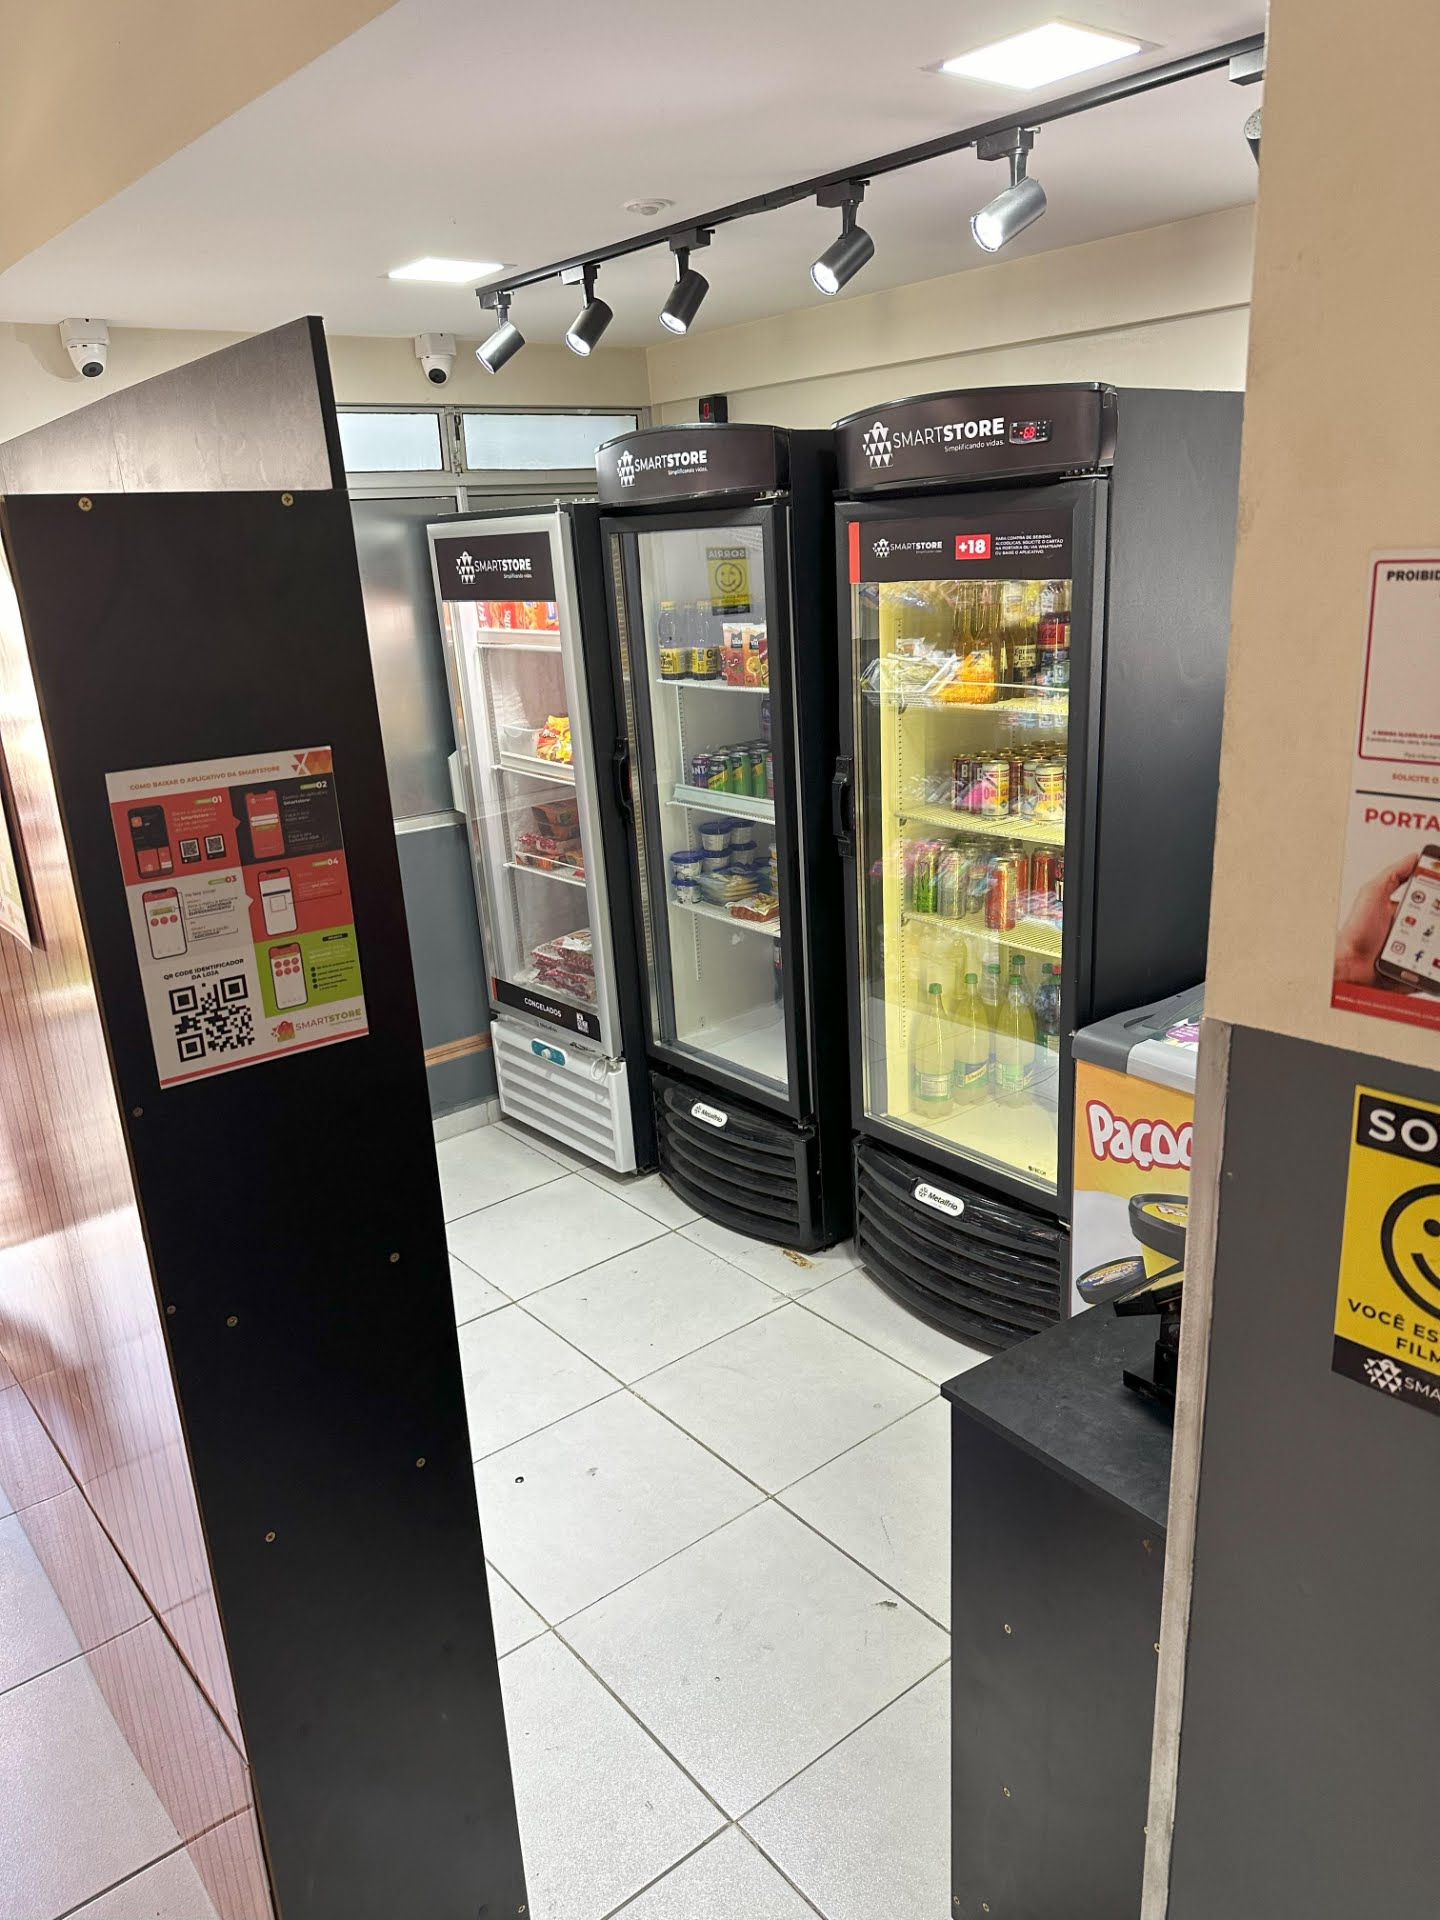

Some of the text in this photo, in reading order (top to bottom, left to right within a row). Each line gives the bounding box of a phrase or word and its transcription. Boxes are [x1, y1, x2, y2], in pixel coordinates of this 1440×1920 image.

[892, 417, 1005, 448] SMARTSTORE
[944, 442, 985, 452] Simplificando
[634, 450, 708, 472] SMARTSTORE
[890, 541, 943, 551] SMARTSTORE
[958, 539, 986, 554] +18
[474, 558, 532, 572] SMARTSTORE
[152, 779, 179, 788] BAIXAR
[186, 773, 226, 784] APLICATIVO
[238, 766, 280, 776] SMARTSTORE
[316, 780, 328, 789] 02
[1392, 773, 1430, 784] SOLICITE
[211, 795, 222, 804] 01
[327, 858, 339, 866] 04
[225, 875, 237, 884] 03
[174, 970, 193, 978] CODE
[194, 958, 244, 974] IDENTIFICADOR
[202, 970, 220, 978] LOJA
[524, 997, 562, 1018] CONGELADOS
[296, 1008, 362, 1031] SMARTSTORE
[1368, 1108, 1439, 1153] SO
[928, 1192, 958, 1211] Metalfrio
[1348, 1298, 1439, 1344] VOCÊ ES
